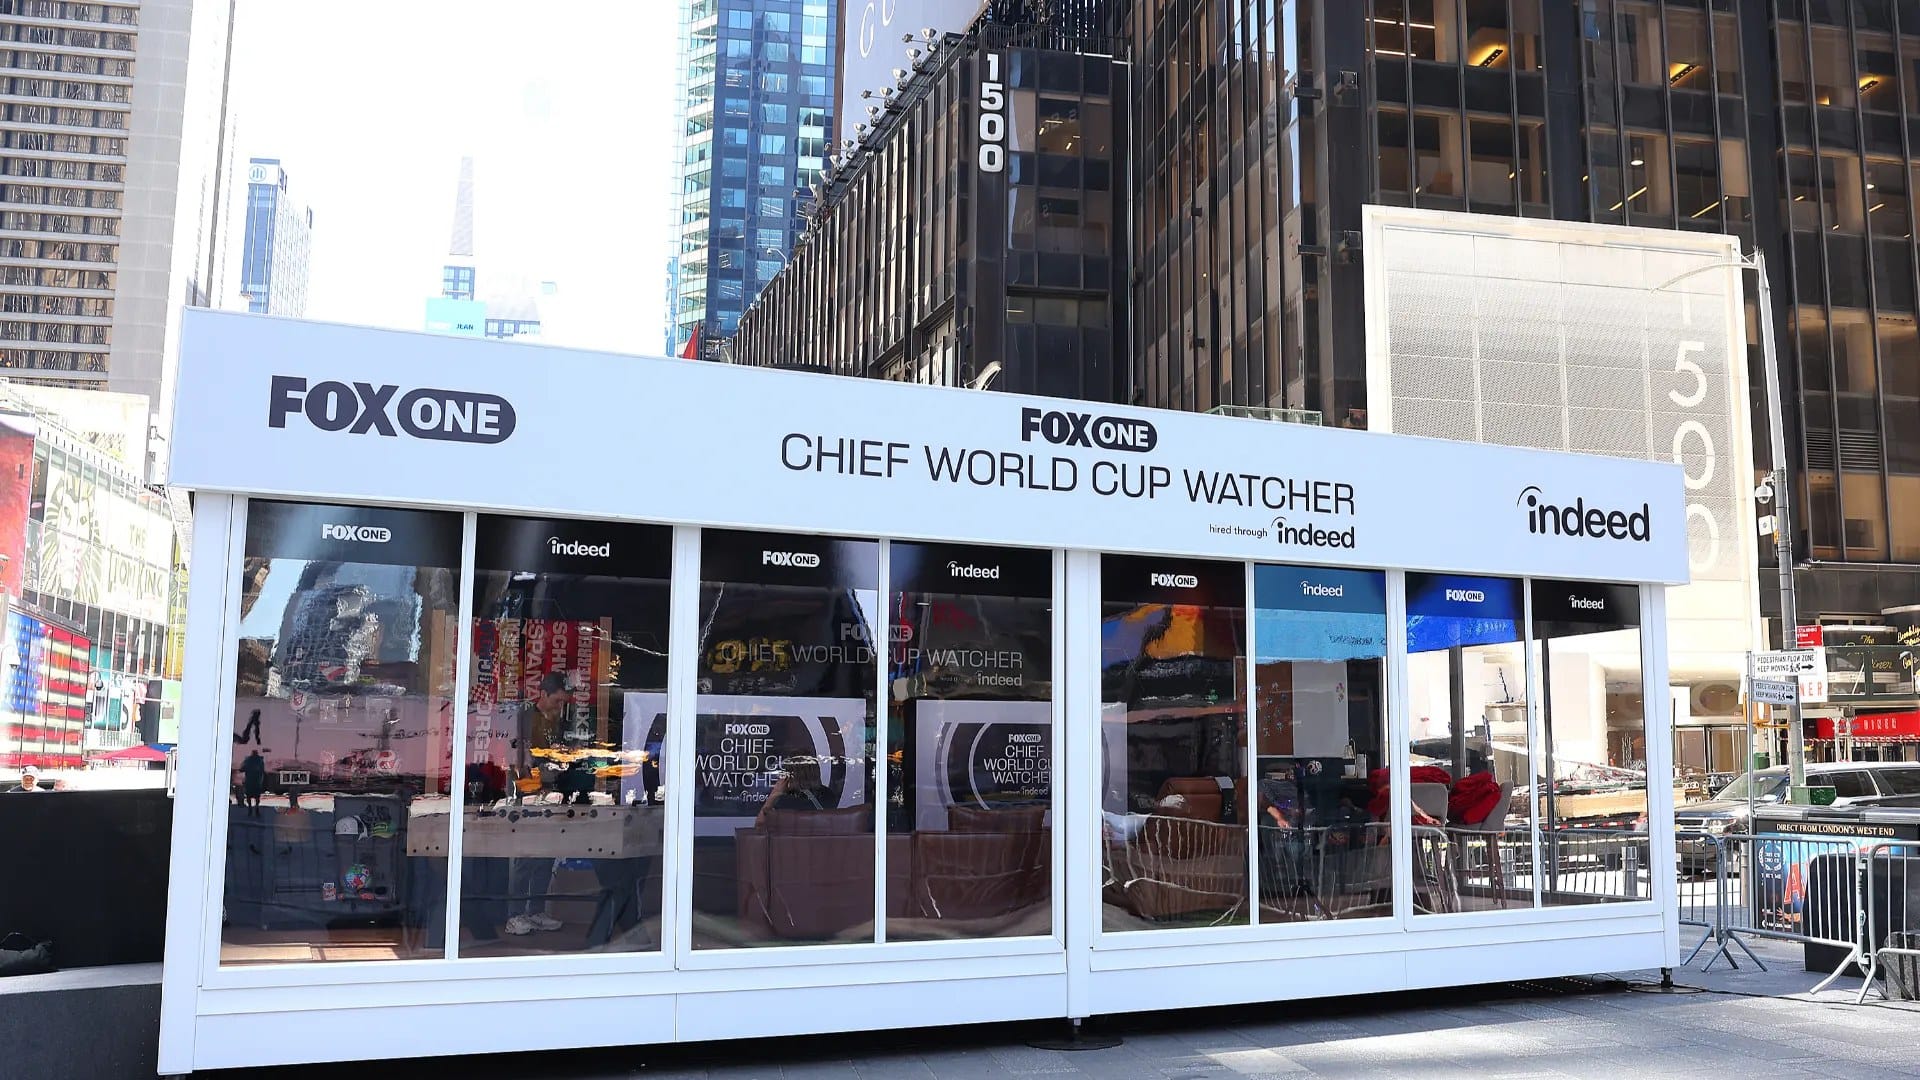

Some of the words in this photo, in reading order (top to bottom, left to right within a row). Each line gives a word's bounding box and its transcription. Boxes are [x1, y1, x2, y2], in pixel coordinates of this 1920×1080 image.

[979, 53, 1004, 173] 1500
[268, 375, 400, 437] FOX
[406, 393, 506, 440] ONE
[1021, 407, 1092, 447] FOX
[1096, 419, 1153, 449] ONE
[781, 433, 910, 478] CHIEF
[923, 445, 1078, 492] WORLD
[1091, 461, 1171, 499] CUP
[1183, 469, 1355, 515] WATCHER
[1524, 492, 1651, 542] indeed
[322, 524, 358, 542] FOX
[360, 528, 388, 541] ONE
[1209, 524, 1232, 536] hired
[1233, 526, 1268, 539] through
[1274, 519, 1355, 549] indeed
[550, 538, 610, 557] indeed
[763, 550, 793, 567] FOX
[793, 555, 818, 566] ONE
[949, 563, 1000, 579] indeed
[1151, 573, 1177, 587] FOX
[1177, 577, 1196, 587] ONE
[1301, 583, 1343, 597] indeed
[1446, 589, 1467, 601] FOX
[1467, 592, 1483, 601] ONE
[1569, 597, 1604, 610] indeed
[888, 627, 911, 641] NE
[721, 642, 785, 662] CHIEF
[791, 645, 871, 664] WORLD
[927, 649, 1023, 668] WATCHER
[1801, 654, 1815, 662] ZONE
[977, 672, 1023, 686] indeed
[1799, 681, 1823, 697] NER
[725, 724, 749, 735] FOX
[749, 725, 768, 734] ONE
[720, 738, 774, 754] CHIEF
[1008, 734, 1026, 743] FOX
[1026, 734, 1040, 742] ONE
[1005, 745, 1045, 758] CHIEF
[983, 758, 1034, 771] WORLD
[702, 771, 779, 788] WATCHE
[992, 771, 1052, 784] WATCHE
[1776, 823, 1798, 832] DIRECT
[1799, 824, 1818, 833] FROM
[1818, 824, 1855, 834] LONDON'S
[1856, 826, 1879, 836] WEST
[1879, 827, 1895, 836] END
